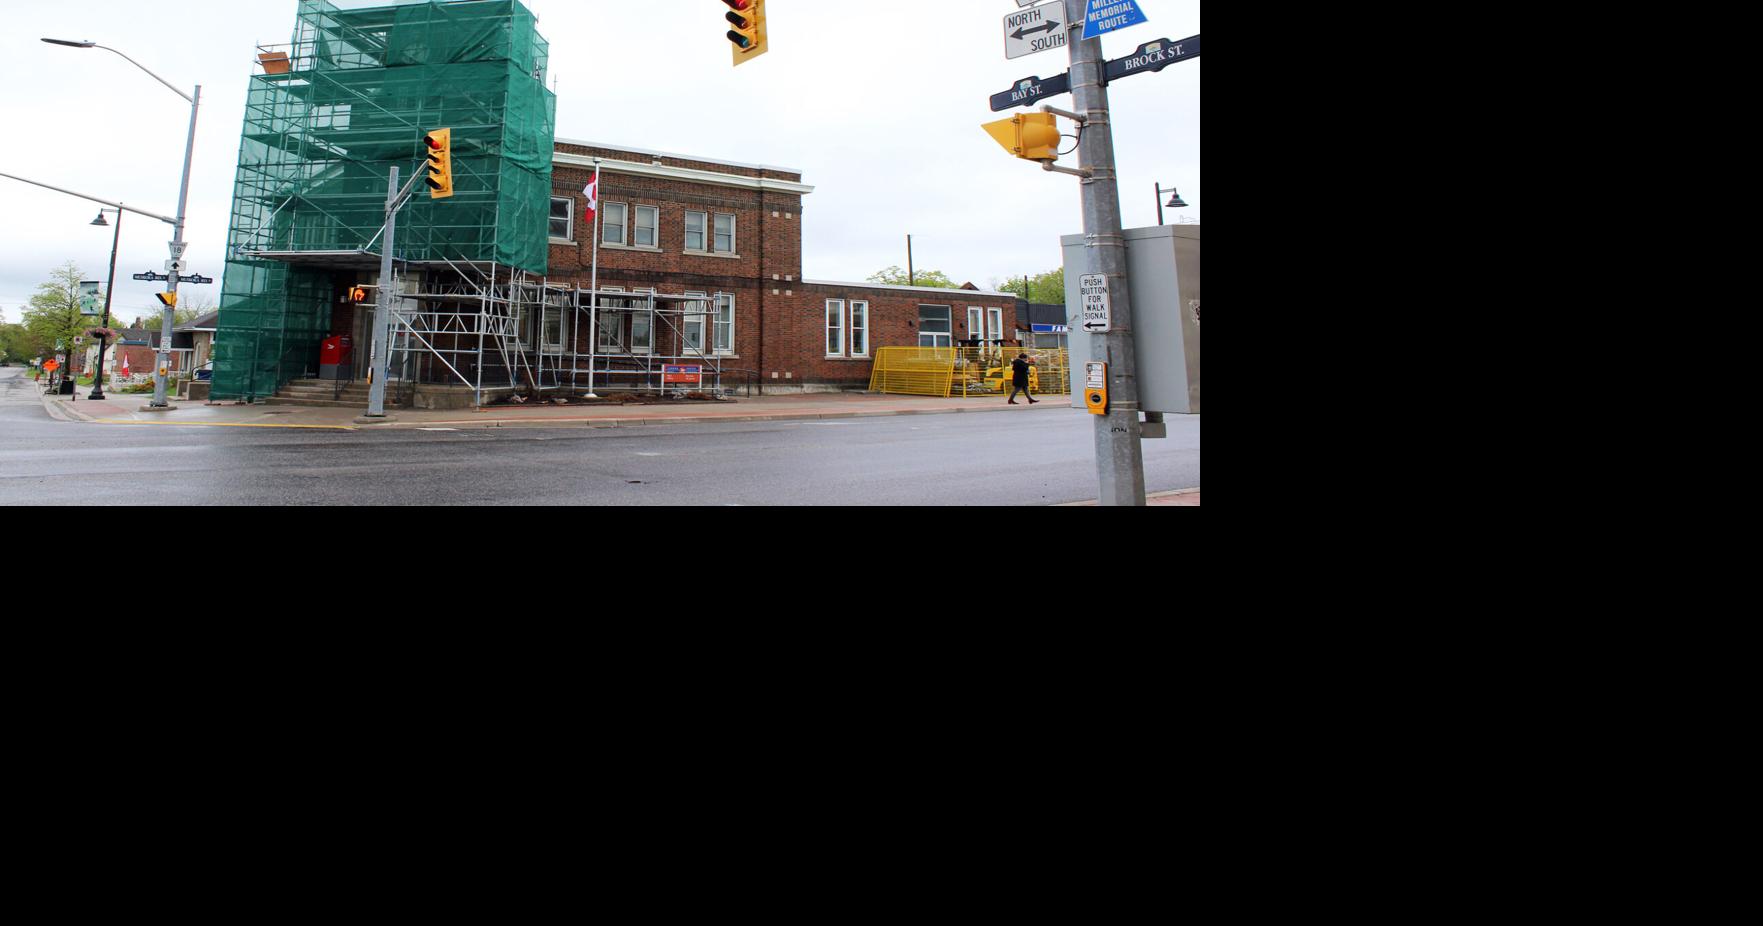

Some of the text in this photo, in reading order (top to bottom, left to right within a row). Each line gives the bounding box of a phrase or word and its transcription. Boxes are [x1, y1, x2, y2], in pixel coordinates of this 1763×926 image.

[1008, 10, 1041, 28] NORTH
[1088, 1, 1134, 22] MEMORIAL
[1098, 14, 1128, 30] ROUTE
[1030, 33, 1066, 52] SOUTH
[1125, 44, 1184, 70] BROCK ST.
[1012, 84, 1043, 101] BAY ST.
[173, 246, 182, 254] 18
[1084, 278, 1102, 286] PUSH
[1081, 287, 1107, 295] BUTTON
[1084, 312, 1107, 320] SIGNAL
